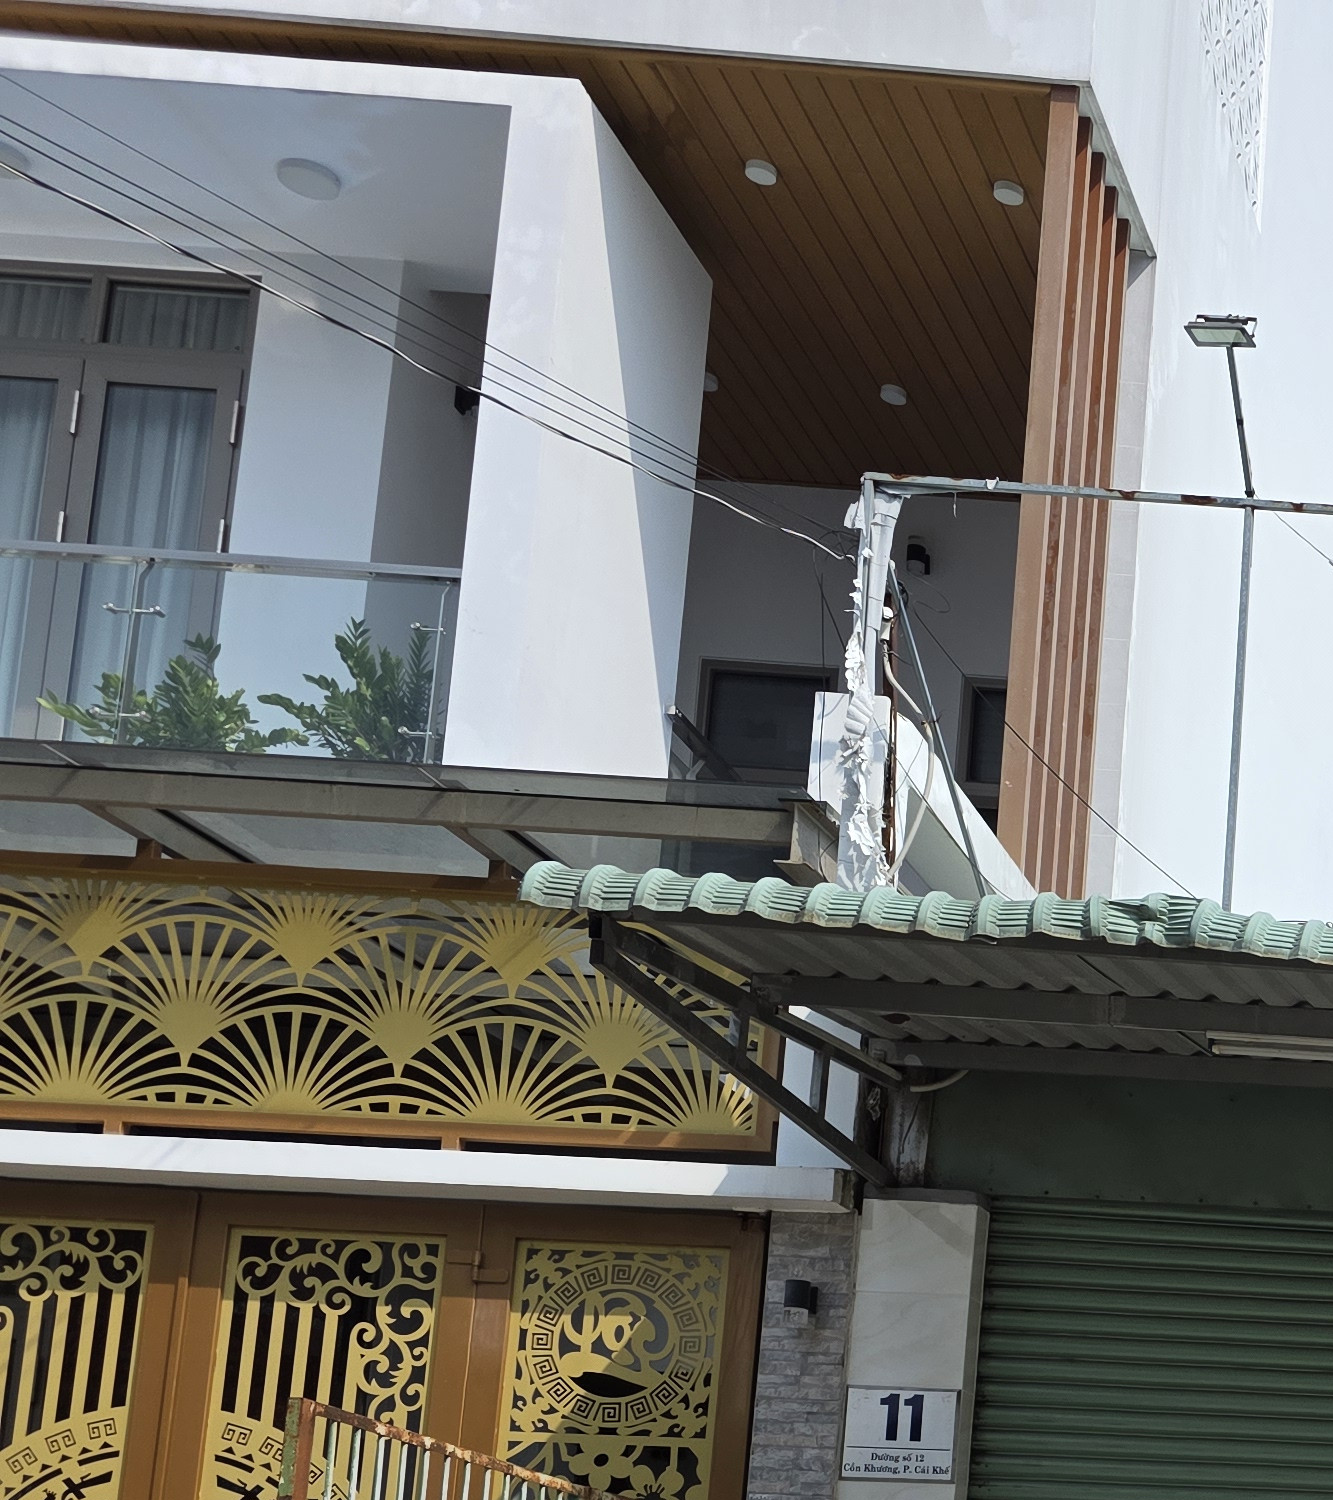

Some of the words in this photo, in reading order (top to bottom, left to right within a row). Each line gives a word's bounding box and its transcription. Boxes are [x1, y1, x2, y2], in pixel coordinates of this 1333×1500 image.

[880, 1393, 925, 1442] 11
[902, 1453, 913, 1462] số
[915, 1454, 925, 1462] 12
[903, 1466, 912, 1474] P.
[914, 1466, 929, 1474] Cái
[932, 1465, 950, 1475] Khế
